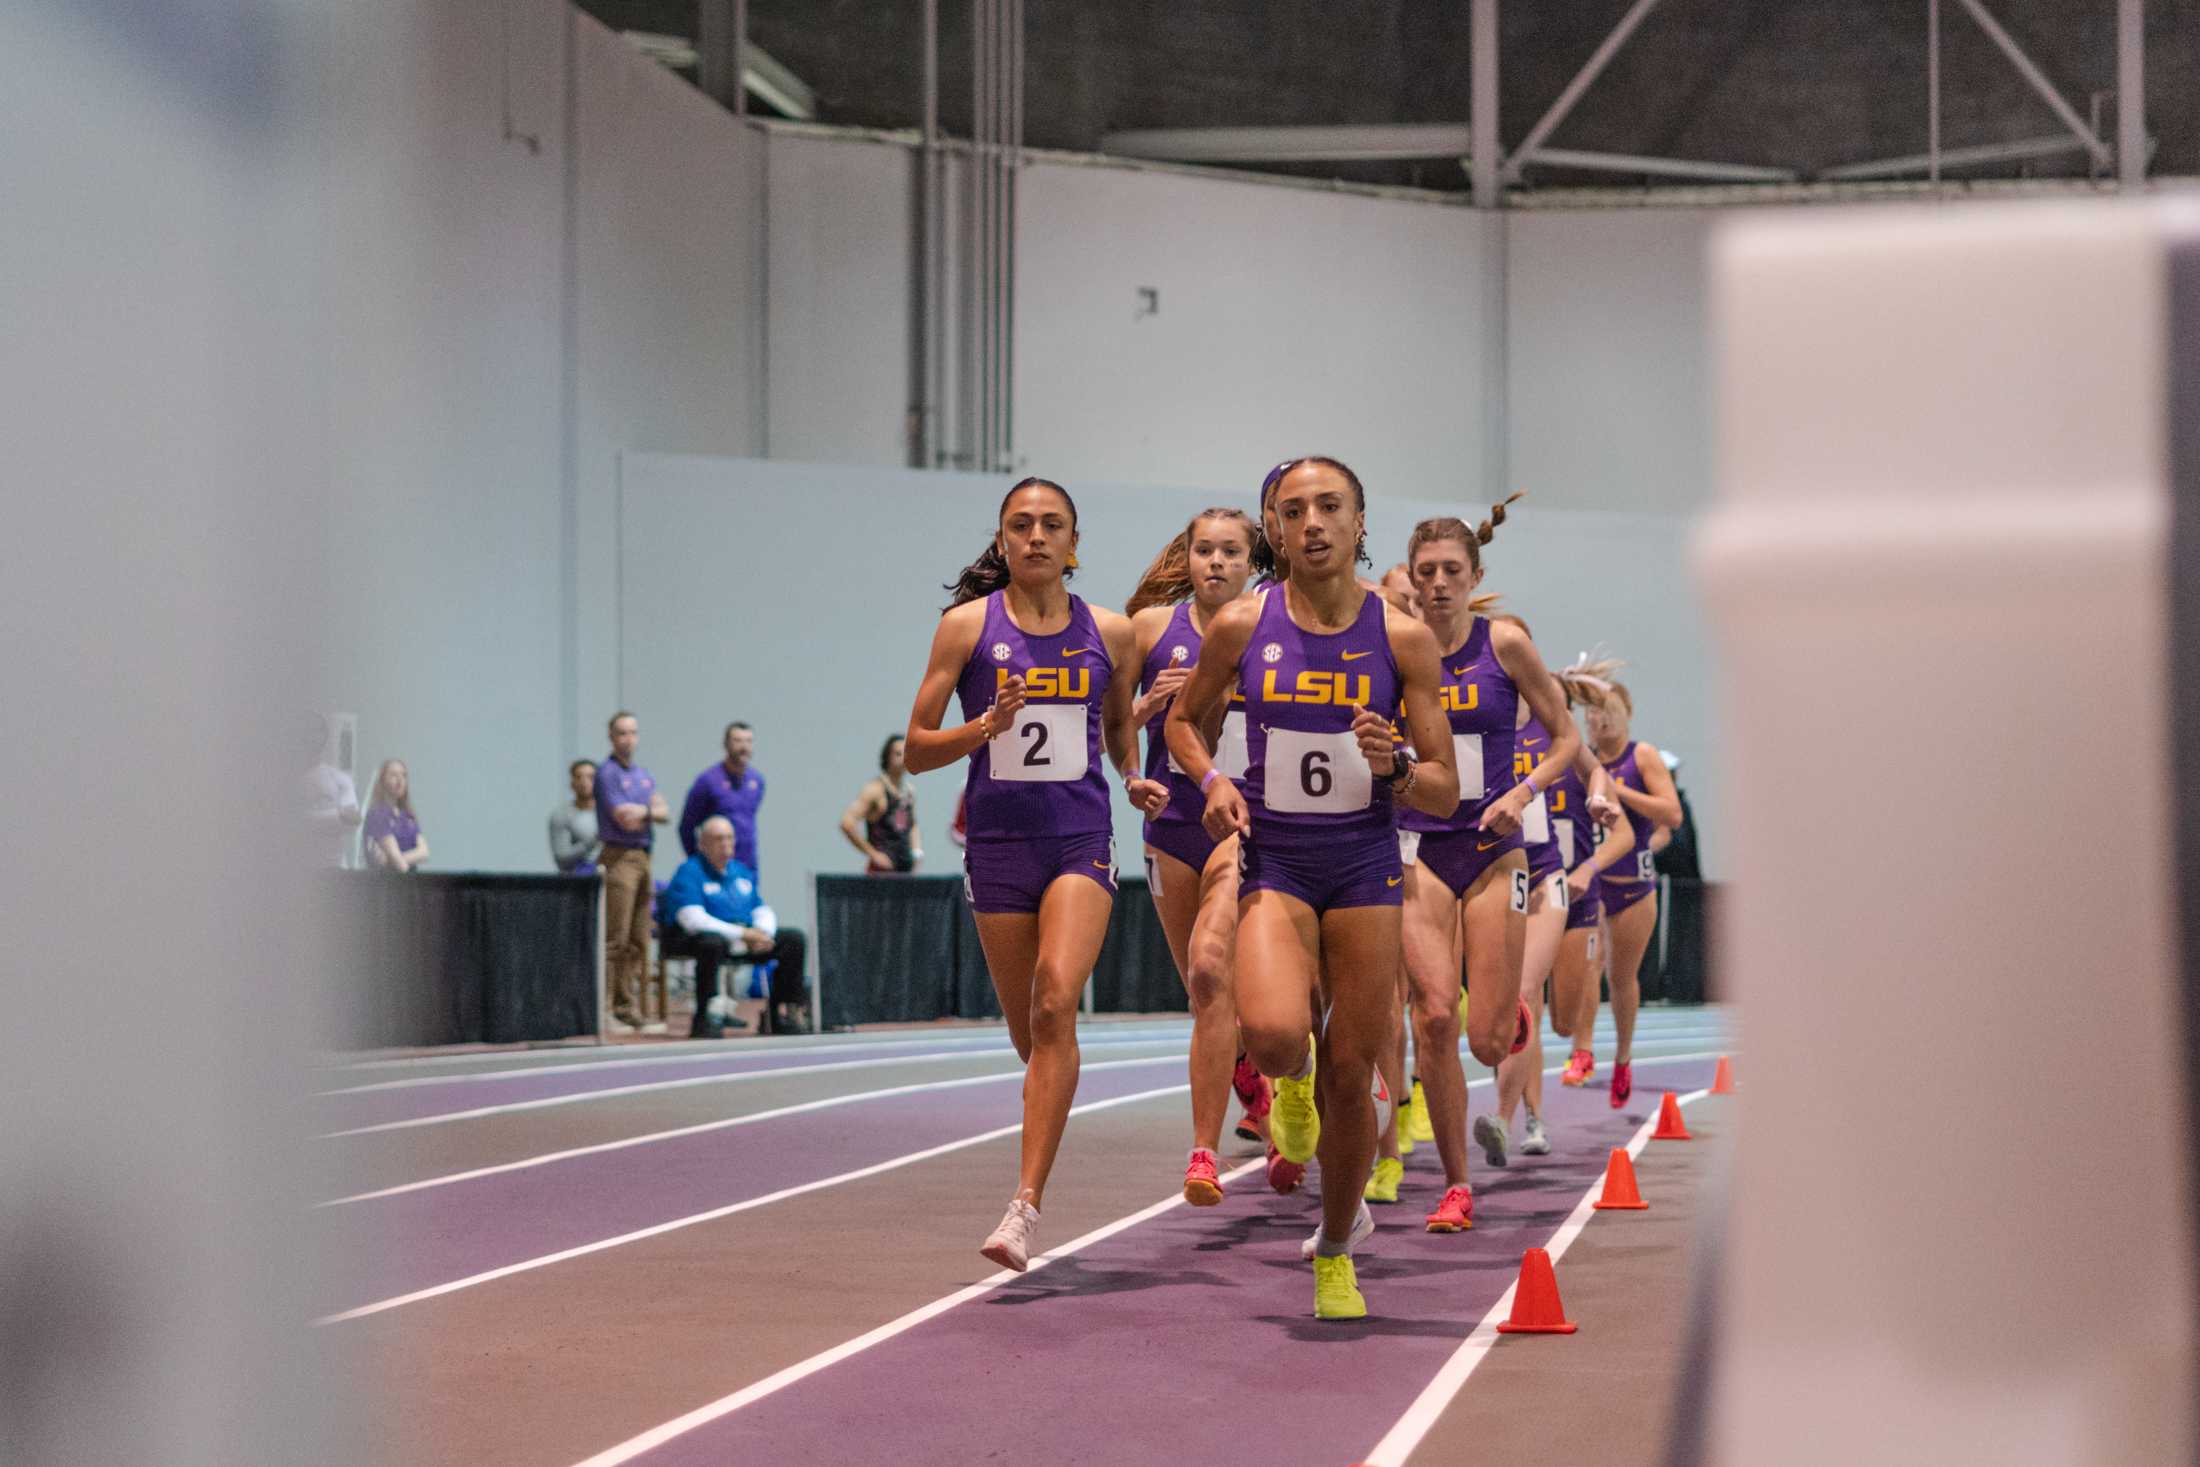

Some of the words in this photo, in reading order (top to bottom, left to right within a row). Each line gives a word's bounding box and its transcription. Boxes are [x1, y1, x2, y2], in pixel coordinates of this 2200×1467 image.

[1262, 669, 1371, 706] LSU
[1020, 722, 1051, 766] 2
[1300, 750, 1332, 797] 6
[1516, 872, 1526, 909] 5
[1555, 877, 1566, 907] 1
